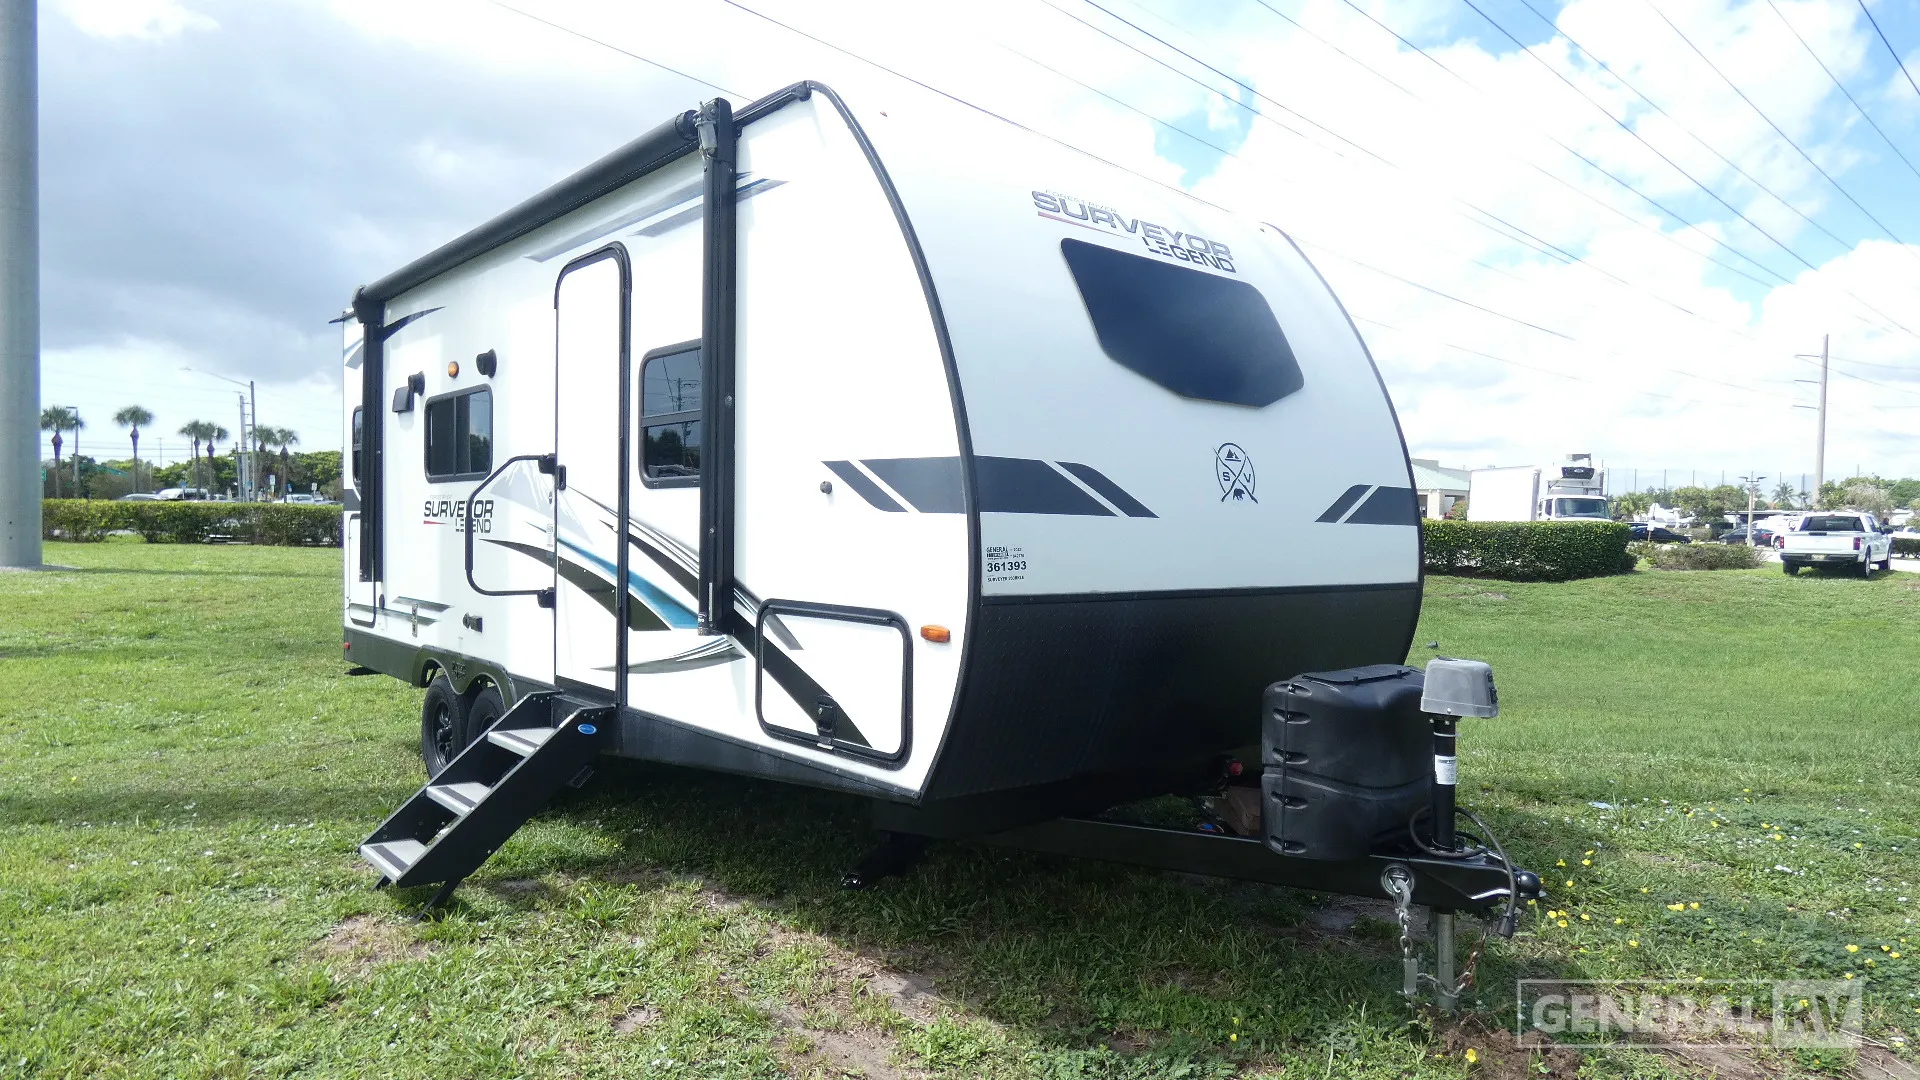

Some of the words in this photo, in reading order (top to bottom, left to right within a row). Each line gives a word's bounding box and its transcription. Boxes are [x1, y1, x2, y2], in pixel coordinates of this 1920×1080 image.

[1031, 190, 1234, 261] SURVEYOR
[1142, 236, 1236, 273] LEGEND
[424, 500, 494, 518] SURVEOR
[455, 518, 492, 533] LEEND
[987, 560, 1027, 572] 361393
